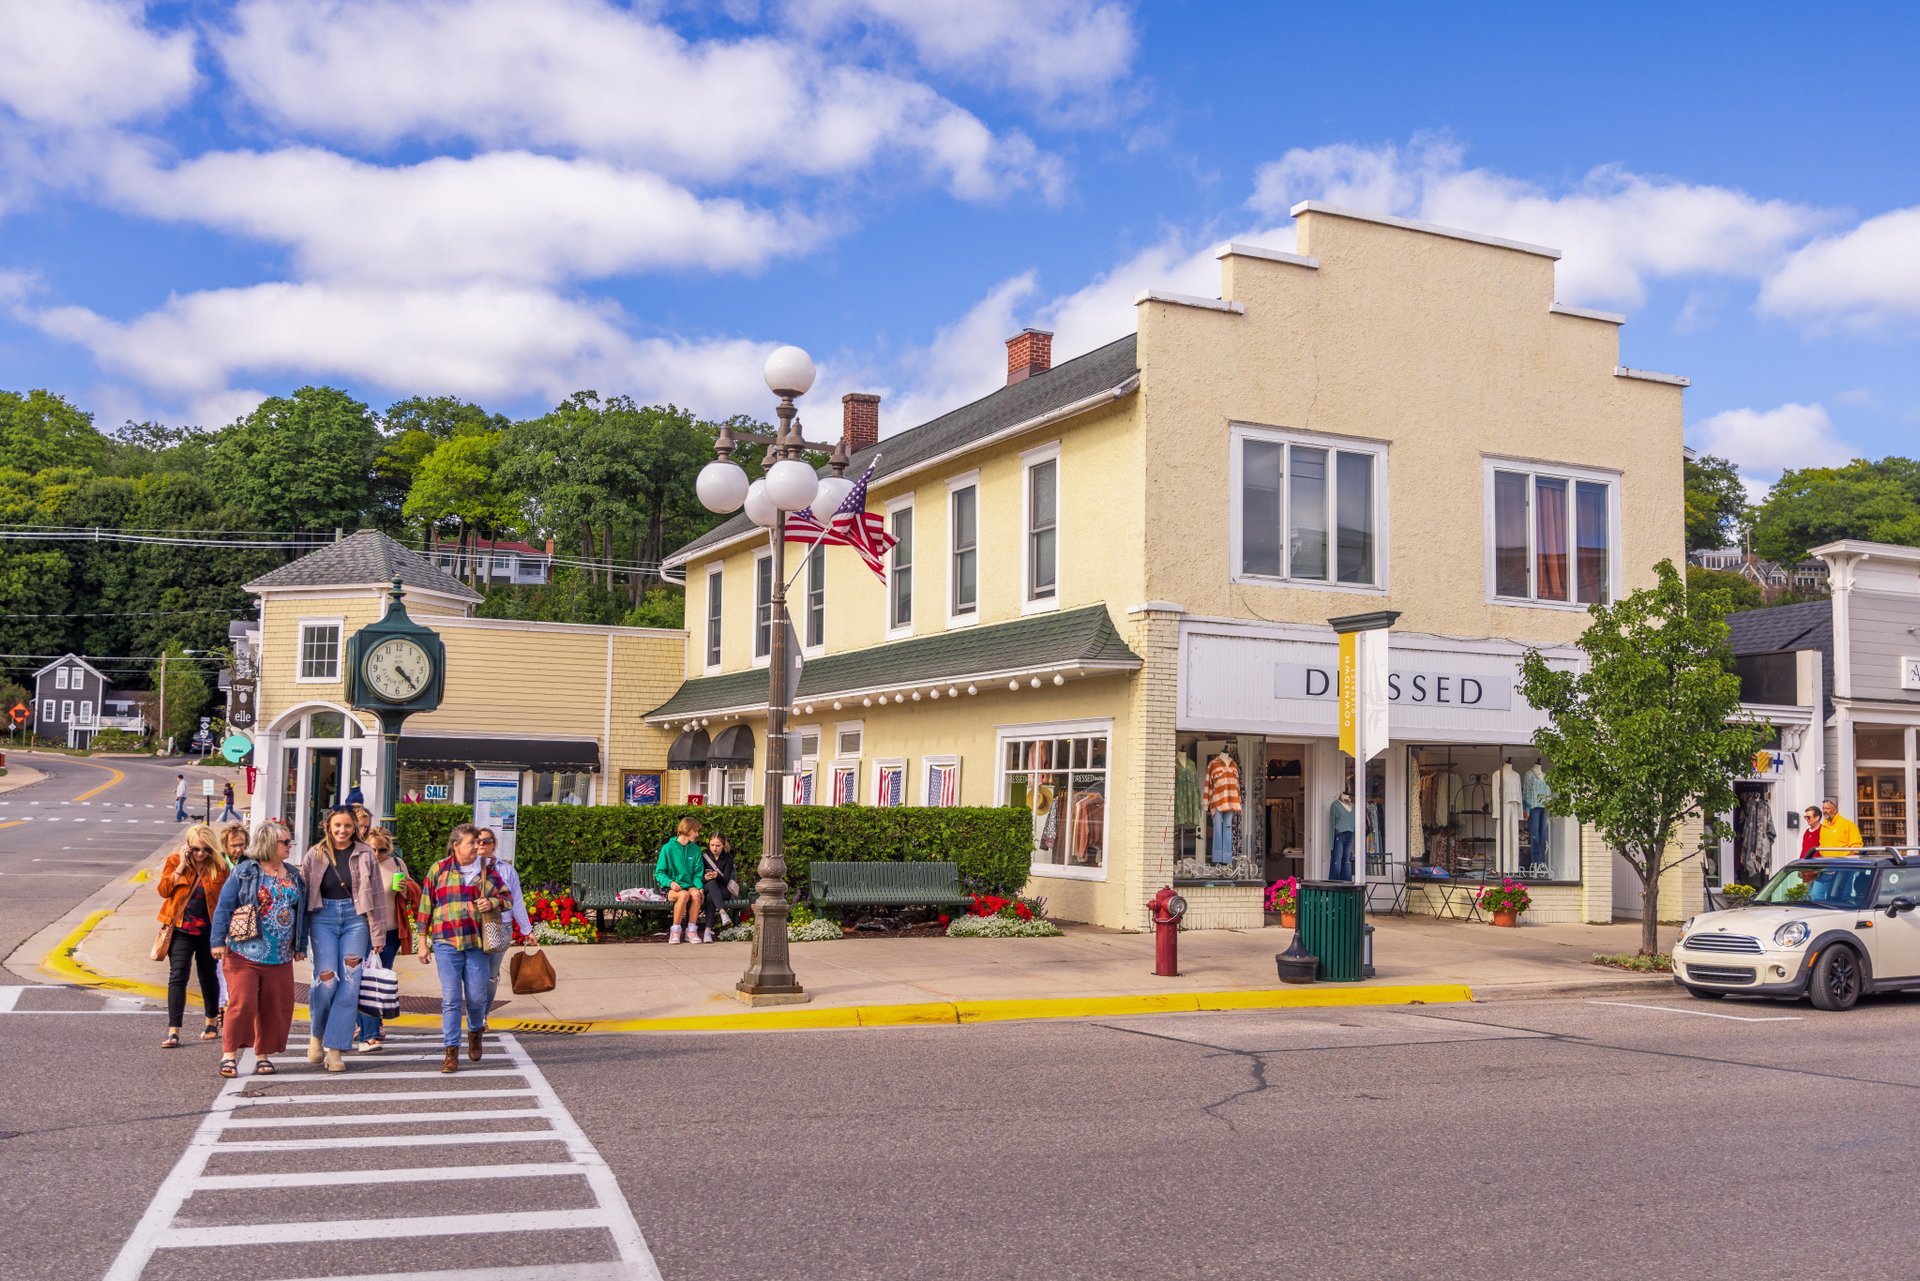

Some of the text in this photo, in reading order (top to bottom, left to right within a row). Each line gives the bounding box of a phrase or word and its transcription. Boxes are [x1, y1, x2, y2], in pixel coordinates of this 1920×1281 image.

[385, 646, 391, 654] 11
[396, 643, 403, 651] 12
[376, 654, 383, 662] 10
[416, 656, 421, 664] 2
[373, 664, 378, 672] 9
[419, 666, 424, 674] 3
[376, 674, 381, 683] 8
[415, 676, 420, 684] 4
[233, 684, 254, 693] L'ESPRIT
[383, 683, 388, 691] 7
[395, 686, 400, 694] 6
[1306, 668, 1483, 704] DSSED
[234, 710, 251, 722] elle
[426, 785, 447, 799] SALE
